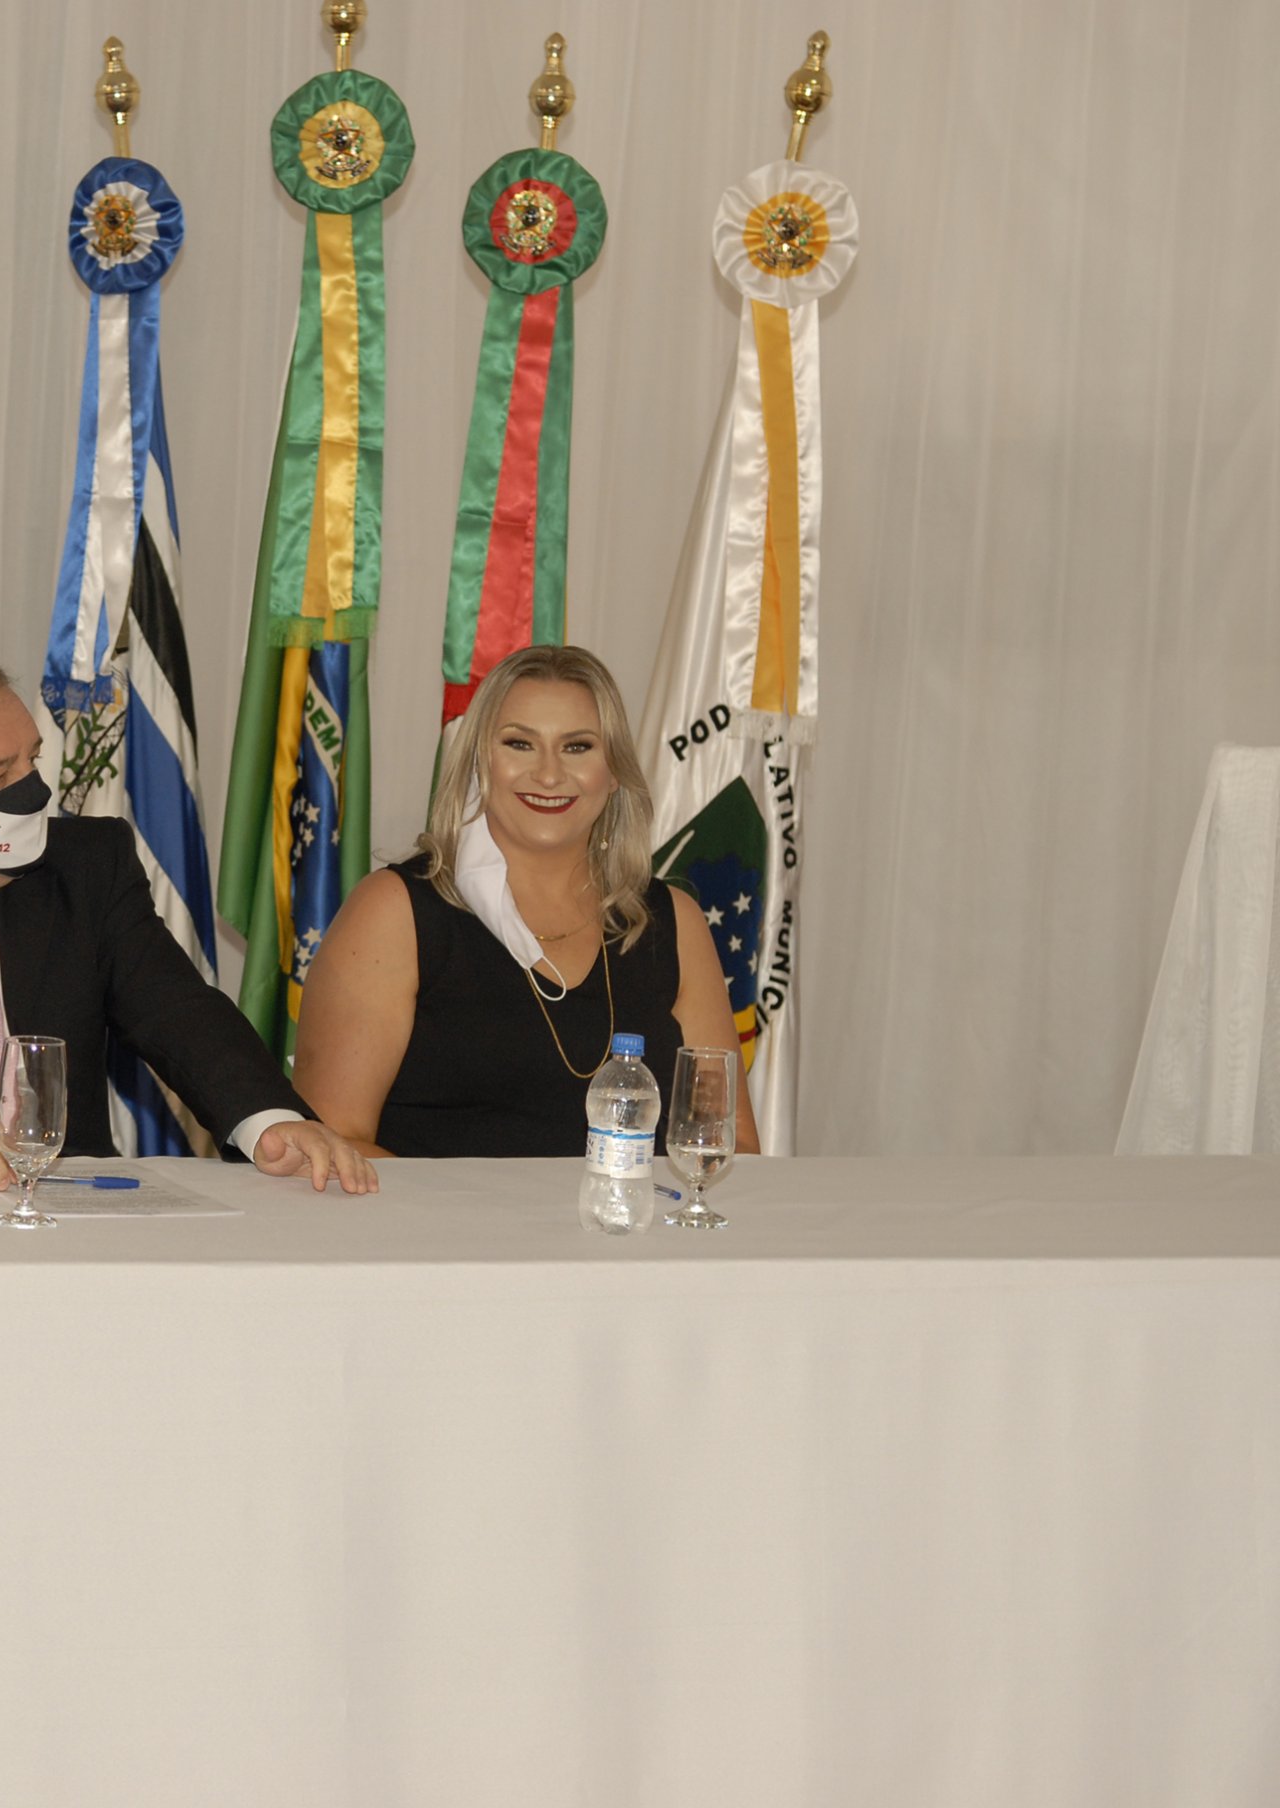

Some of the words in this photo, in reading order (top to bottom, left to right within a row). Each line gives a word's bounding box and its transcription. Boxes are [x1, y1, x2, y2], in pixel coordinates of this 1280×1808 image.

[306, 690, 340, 752] DEM
[669, 704, 731, 762] POD
[763, 735, 797, 870] LATIVO
[756, 901, 792, 1037] MUNICI
